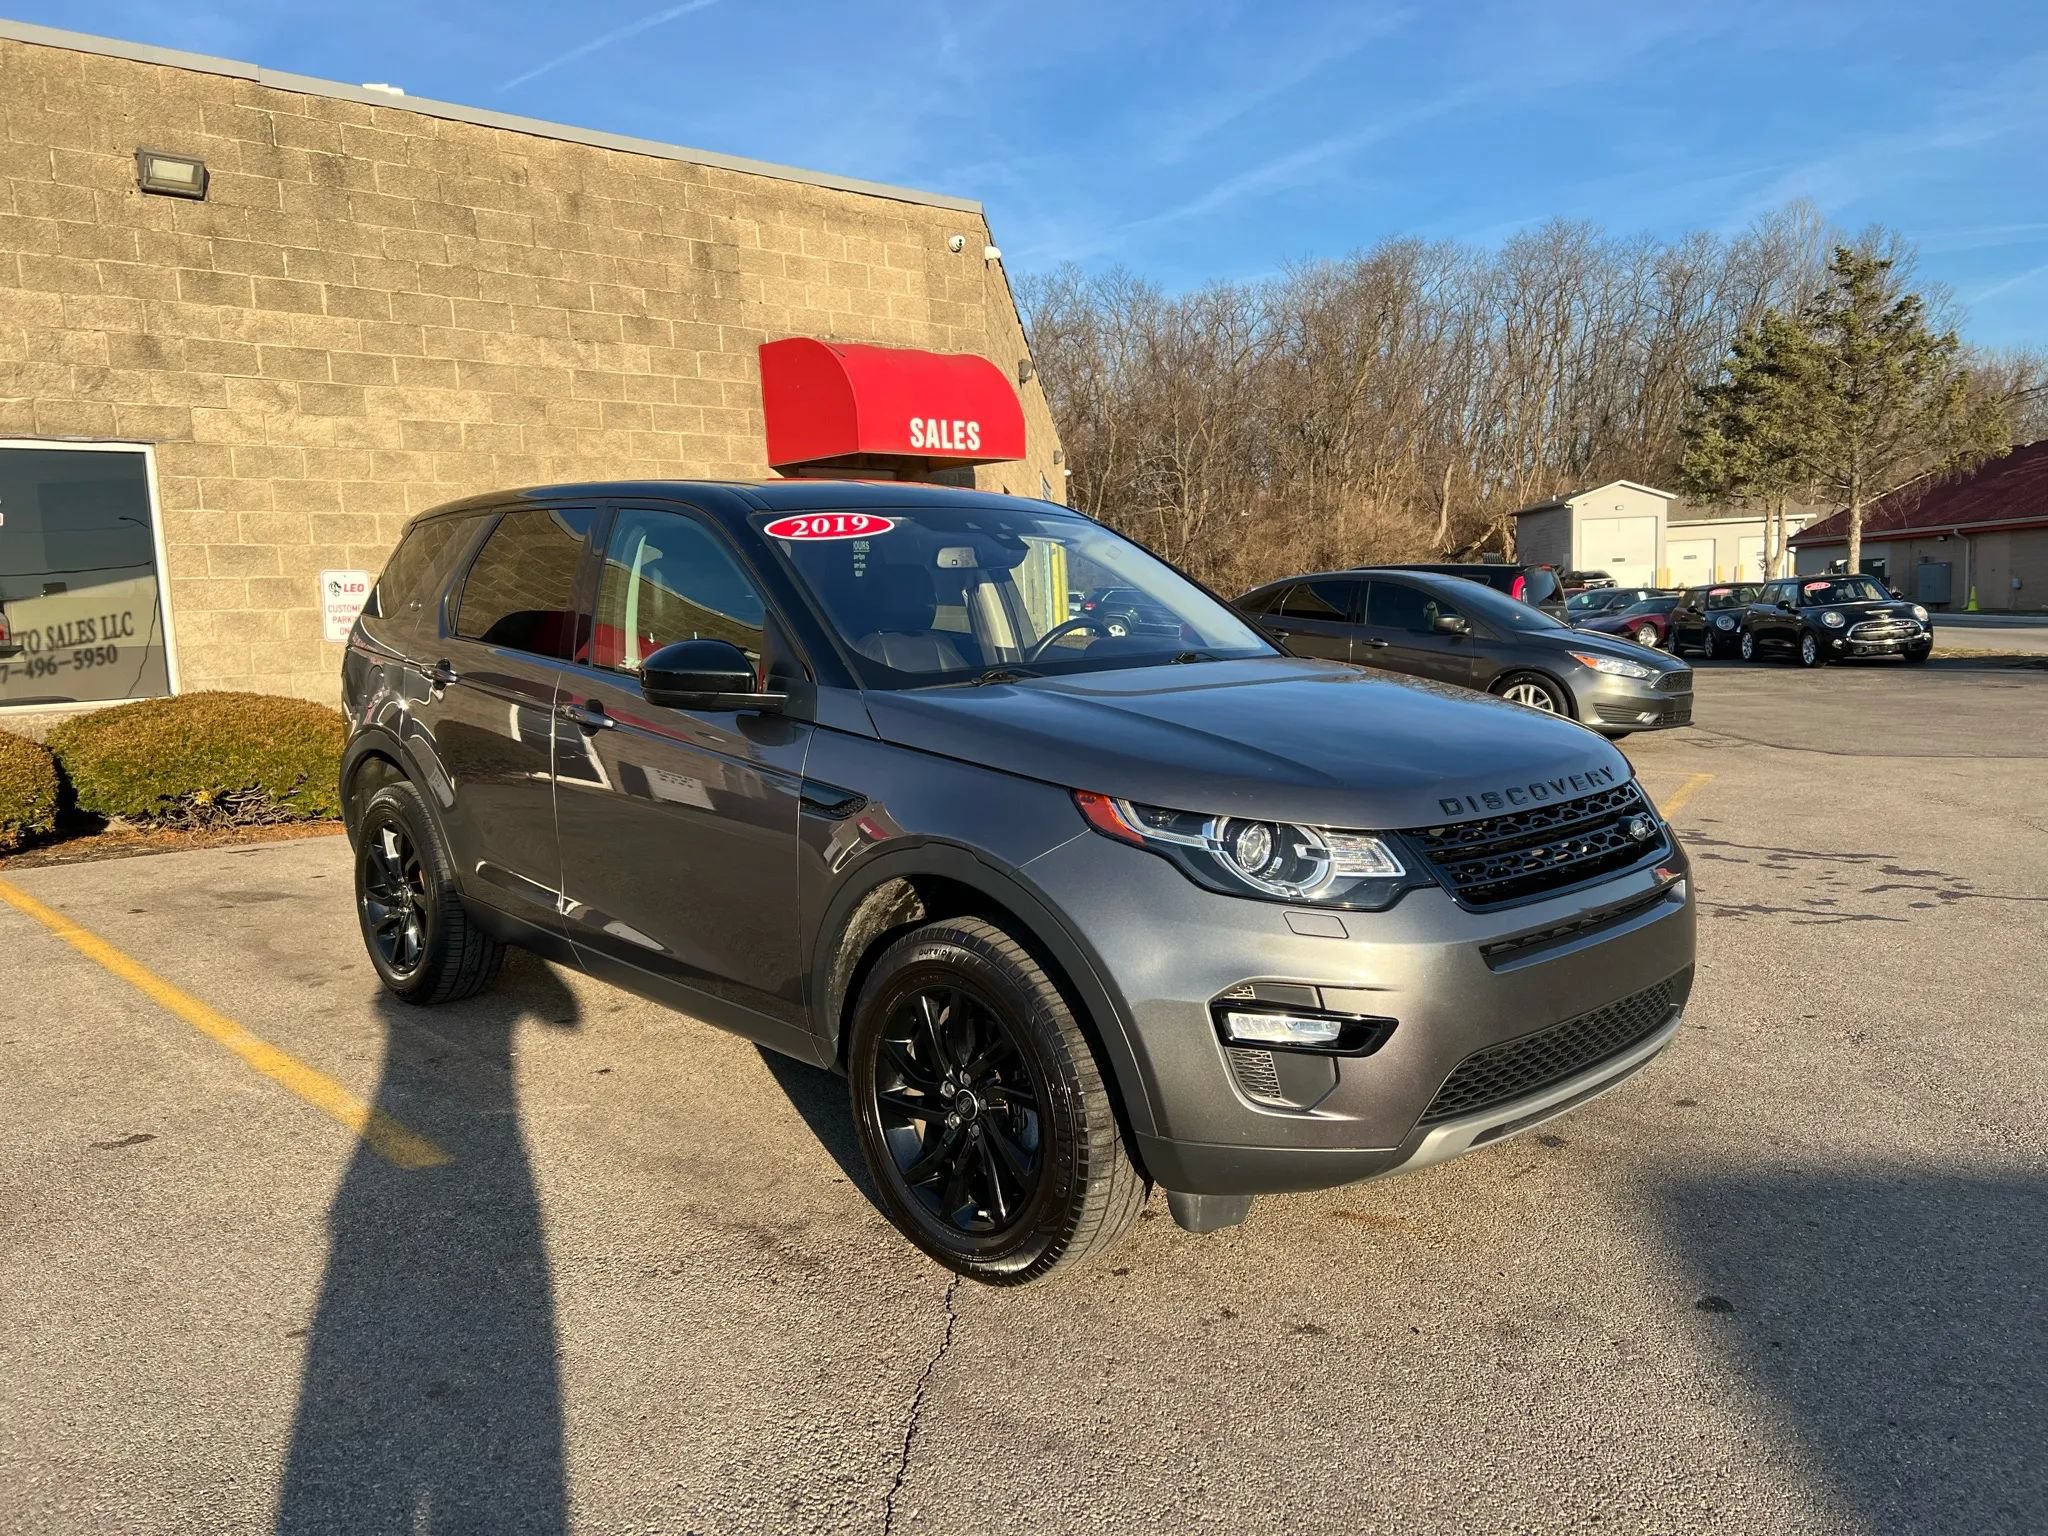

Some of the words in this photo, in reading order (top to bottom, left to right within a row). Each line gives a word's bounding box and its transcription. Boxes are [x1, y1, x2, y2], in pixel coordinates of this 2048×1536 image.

[909, 417, 981, 451] SALES
[791, 516, 869, 537] 2019
[343, 583, 365, 593] LEO
[328, 604, 362, 613] CUSTOME
[46, 618, 97, 651] SALES
[101, 611, 134, 640] LLC
[1438, 766, 1615, 817] DISCOVERY
